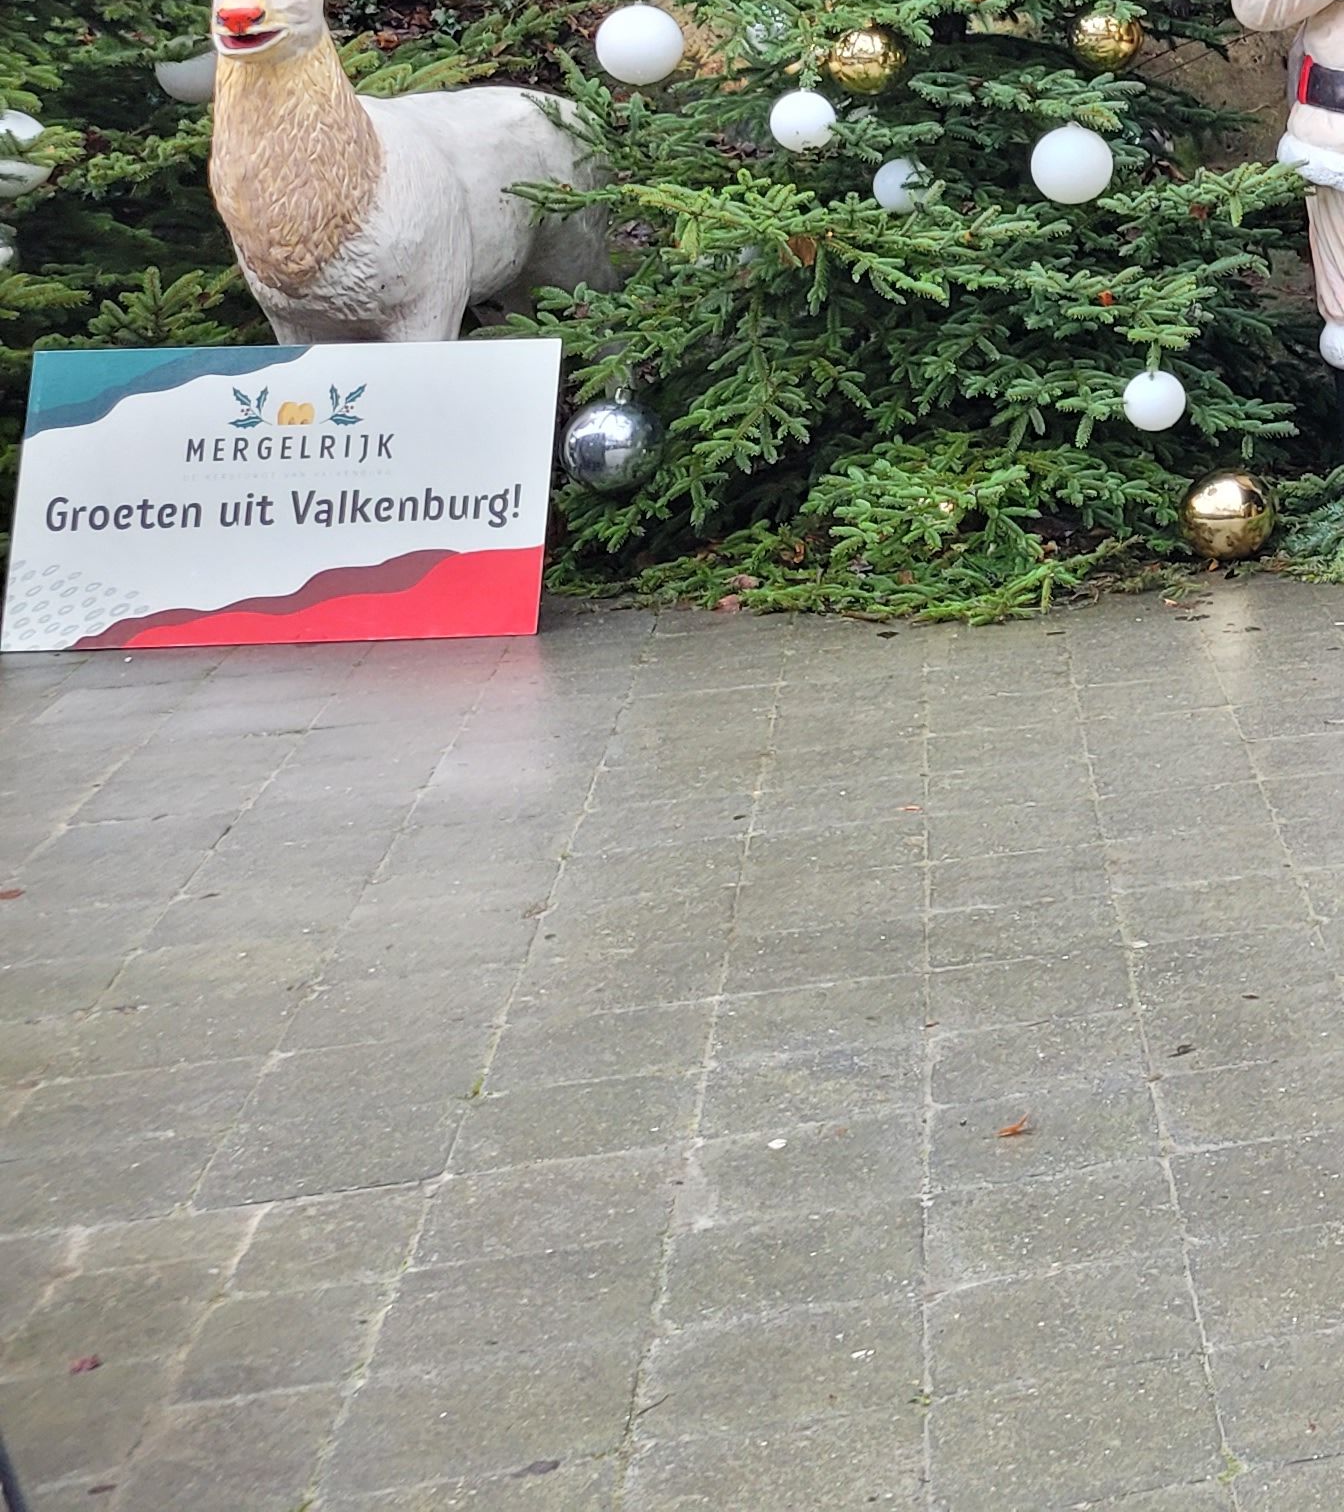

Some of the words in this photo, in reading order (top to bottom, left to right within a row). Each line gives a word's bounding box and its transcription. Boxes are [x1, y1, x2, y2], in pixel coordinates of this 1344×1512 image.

[185, 433, 395, 464] MERGELRIJK
[46, 496, 202, 532] Groeten
[219, 492, 275, 528] uit
[291, 483, 523, 529] Valkenburg!
